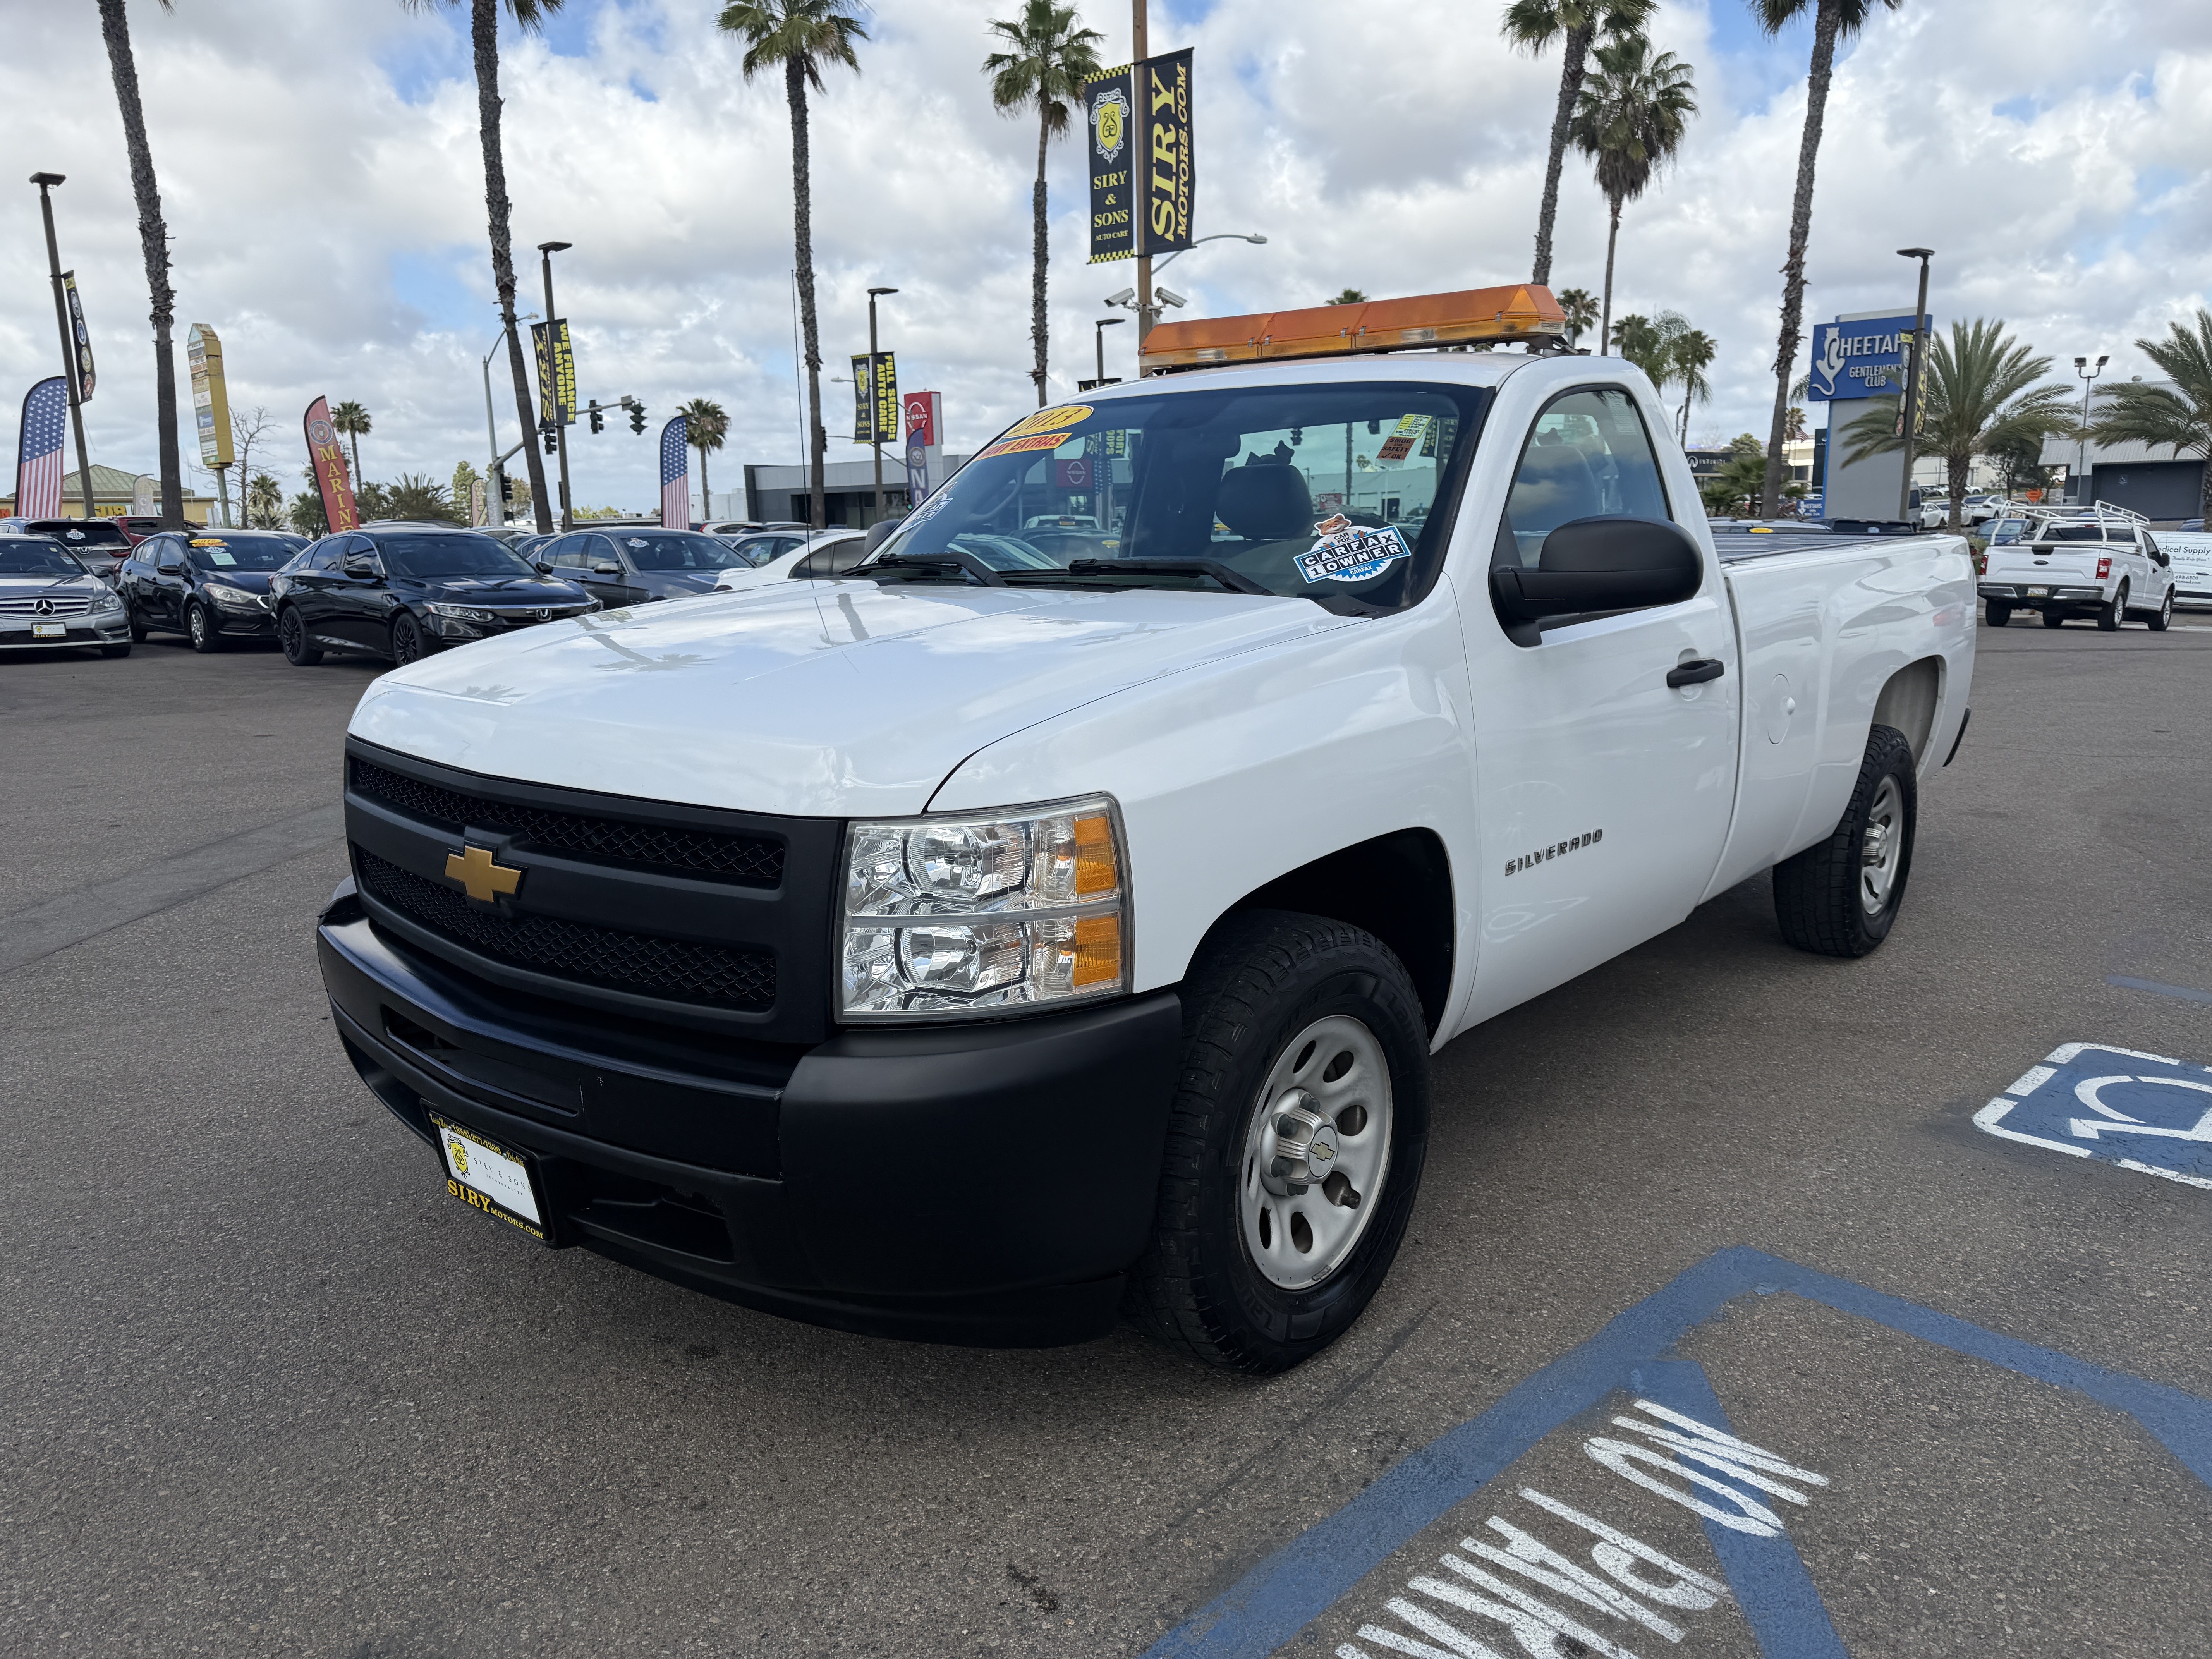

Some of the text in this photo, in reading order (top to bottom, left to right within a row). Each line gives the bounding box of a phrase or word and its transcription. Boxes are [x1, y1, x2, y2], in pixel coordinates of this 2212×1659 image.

[1152, 67, 1176, 242] SIRY
[1176, 62, 1189, 239] MOTORS.COM
[1093, 170, 1127, 189] SIRY
[1105, 193, 1116, 205] &
[1094, 209, 1129, 228] SONS
[1095, 230, 1129, 241] AUTO CARE
[553, 342, 567, 406] ANYONE
[559, 323, 576, 422] WE FINANCE
[1865, 375, 1886, 387] CLUB
[876, 364, 888, 433] AUTO CARE
[885, 355, 897, 440] FULL SERVICE
[1009, 434, 1066, 452] EXTRAS
[1305, 534, 1395, 565] CARFAX
[1334, 532, 1350, 541] CAR
[2182, 546, 2211, 556] Supply
[1310, 567, 1322, 576] 1
[1326, 544, 1401, 571] OWNER
[1350, 565, 1373, 575] CARFAX
[1504, 828, 1603, 877] SILVERADO
[453, 1123, 471, 1140] (858)
[474, 1158, 493, 1173] SIRY
[508, 1175, 531, 1192] SONS
[447, 1179, 545, 1240] SIRY MOTORS.COM
[1583, 1399, 1830, 1538] NO
